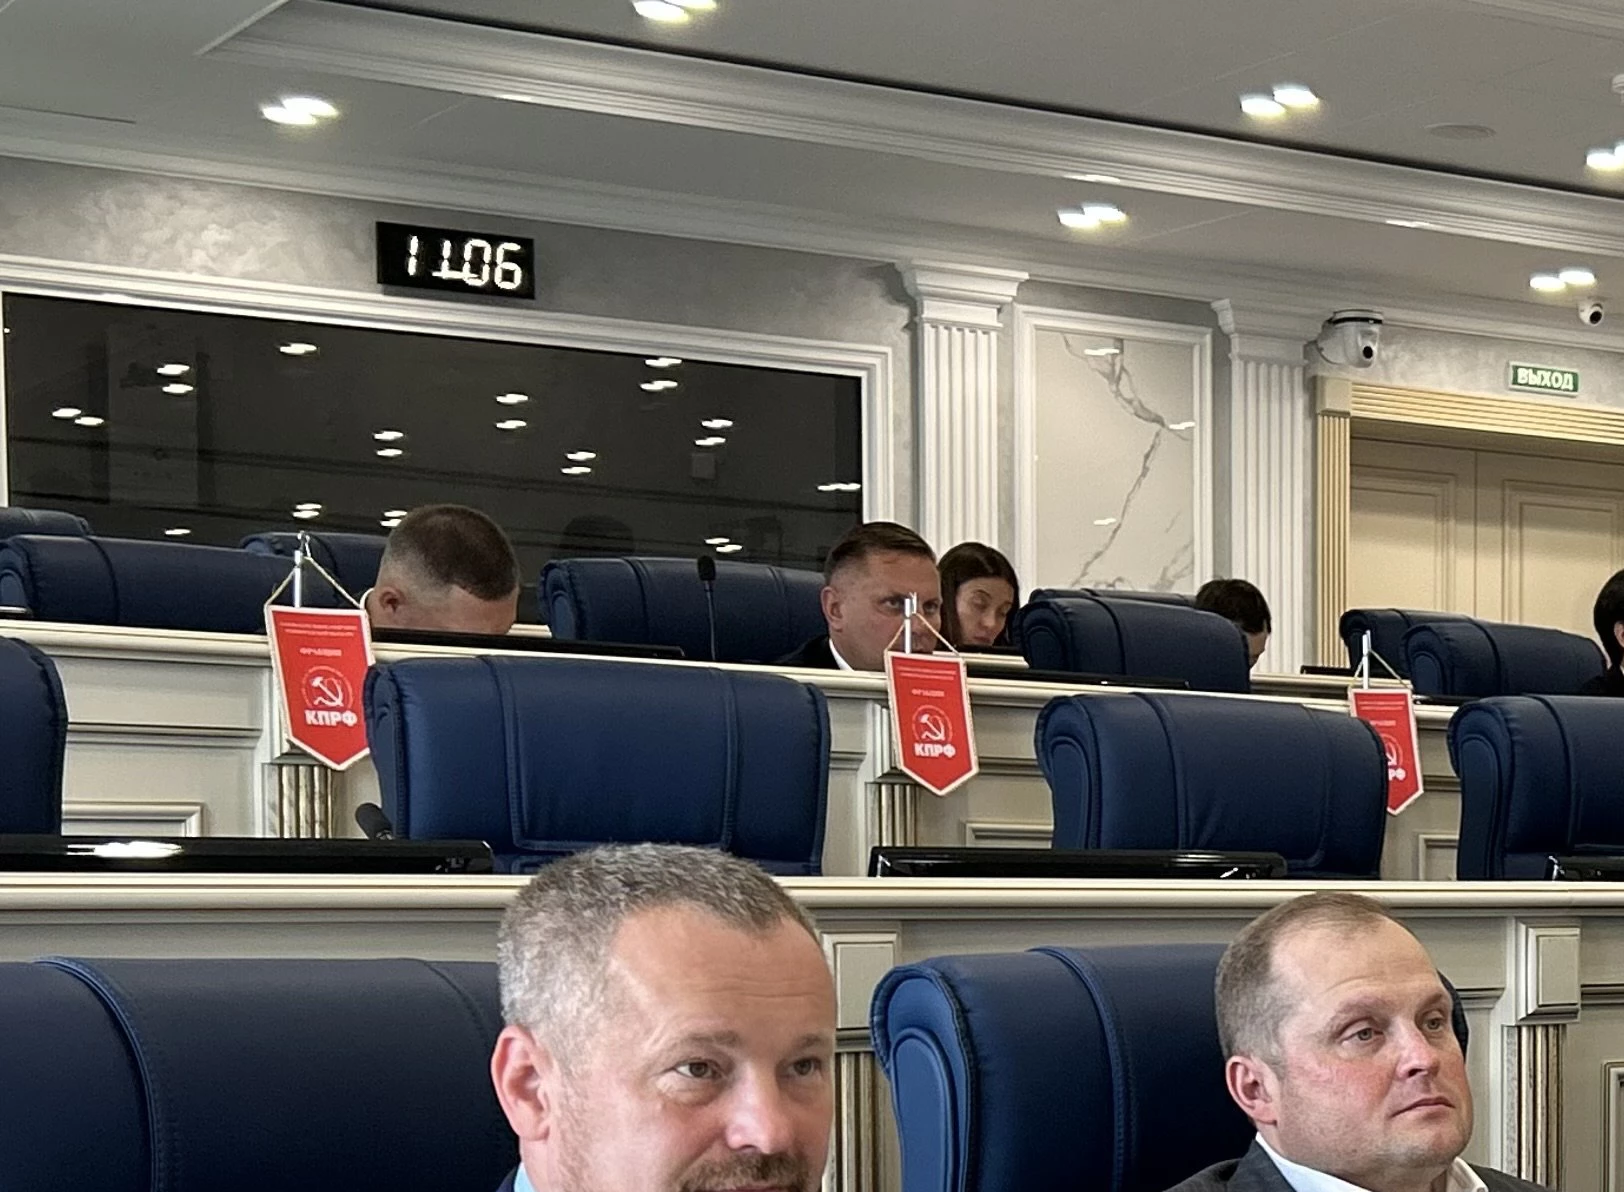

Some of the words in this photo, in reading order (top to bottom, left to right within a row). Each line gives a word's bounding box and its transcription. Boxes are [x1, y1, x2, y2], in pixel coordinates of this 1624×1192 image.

[1517, 367, 1574, 391] ВЫХОД
[305, 709, 358, 727] КПРФ
[914, 743, 956, 758] КПРФ
